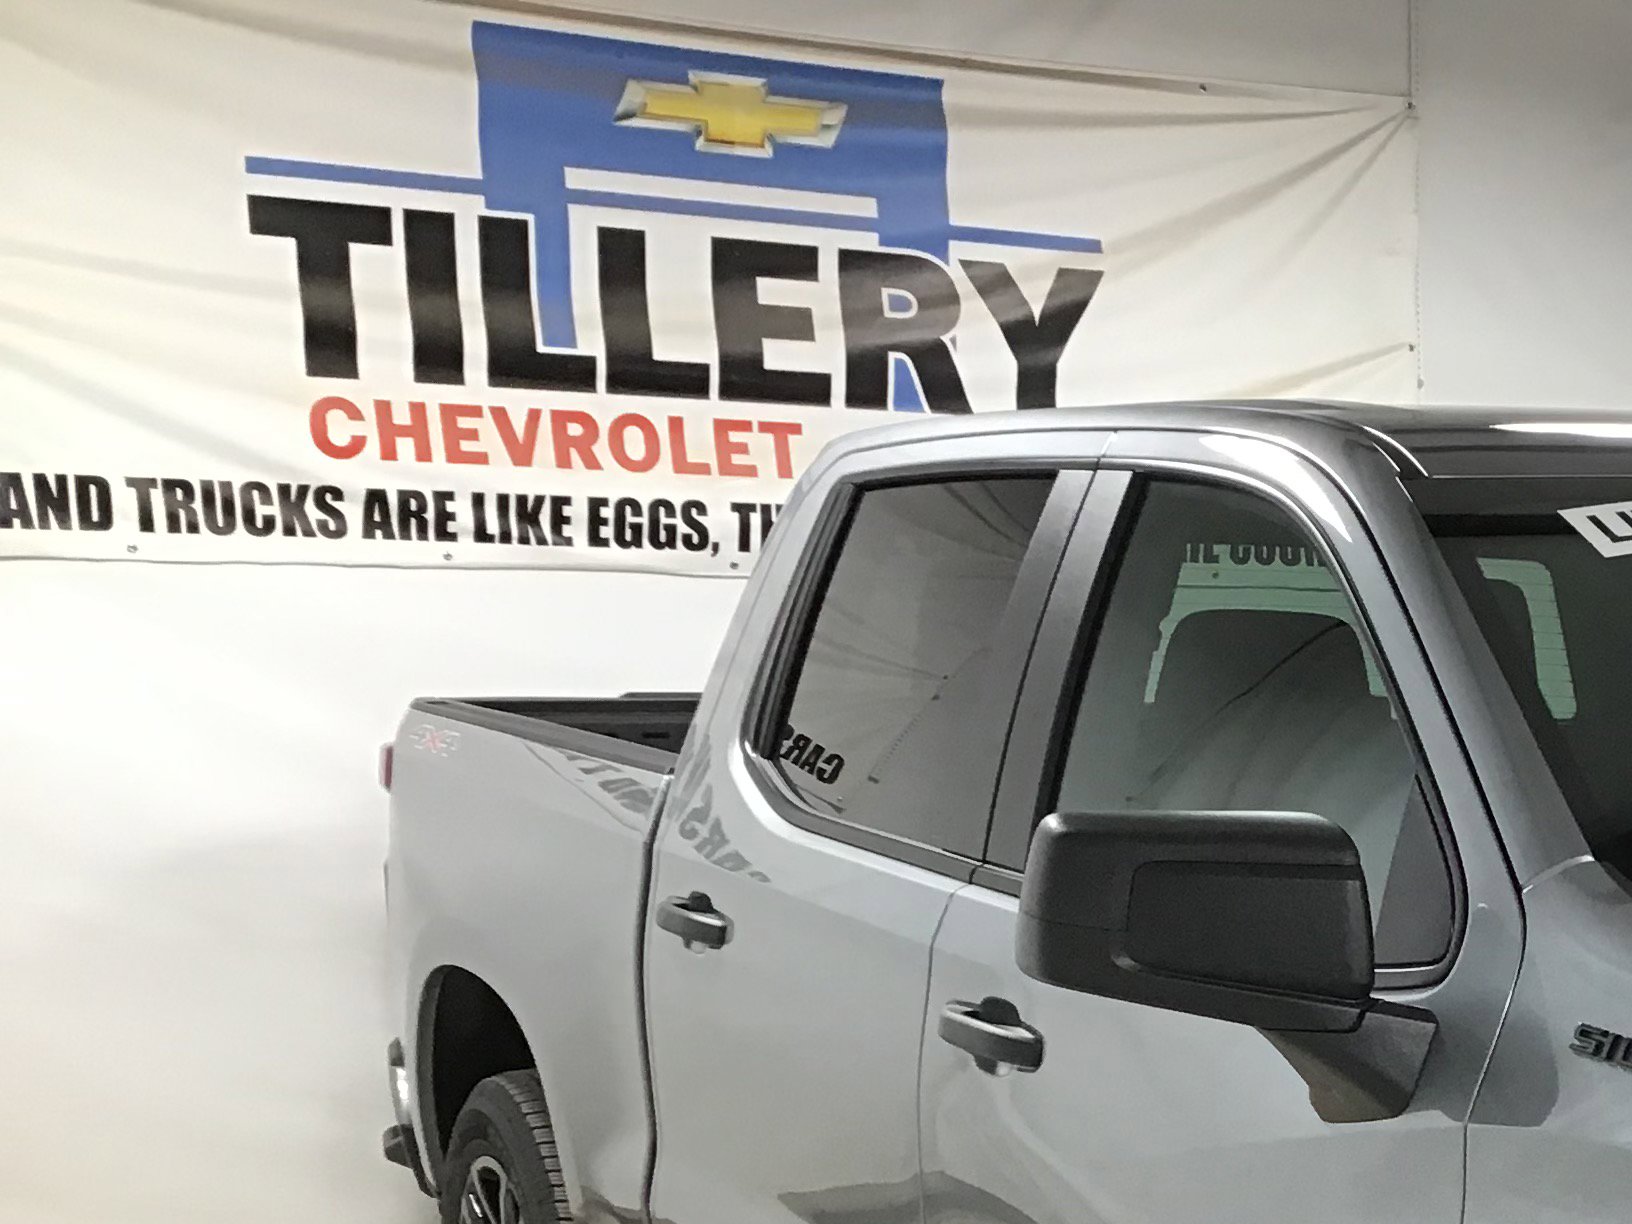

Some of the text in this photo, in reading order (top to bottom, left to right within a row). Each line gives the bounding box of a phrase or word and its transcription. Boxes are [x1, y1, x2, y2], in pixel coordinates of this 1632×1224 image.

[246, 194, 1105, 414] TILLERY
[309, 395, 804, 480] CHEVROLET
[0, 472, 114, 532] AND
[124, 476, 348, 540] TRUCKS
[361, 488, 459, 543] ARE
[471, 491, 574, 548] LIKE
[587, 495, 720, 557] EGGS,
